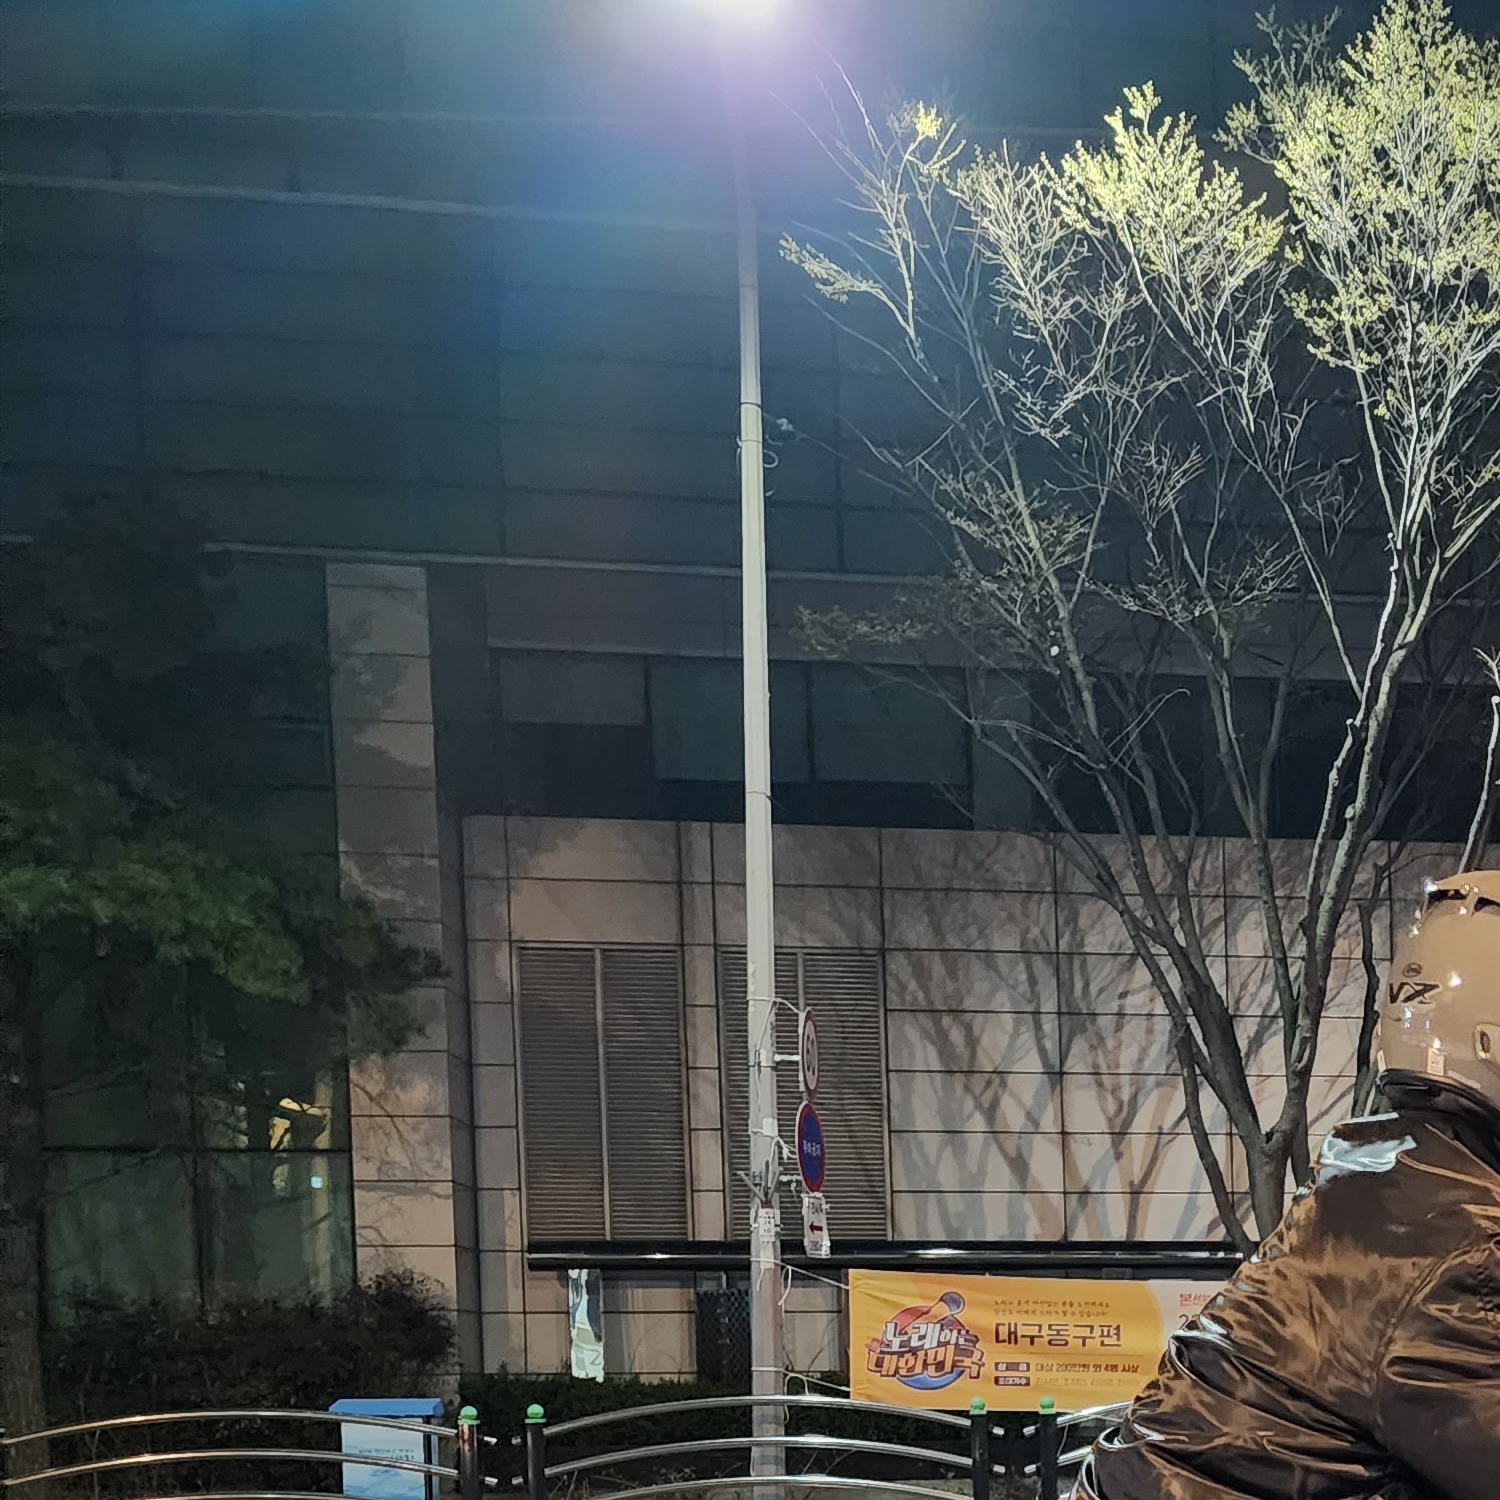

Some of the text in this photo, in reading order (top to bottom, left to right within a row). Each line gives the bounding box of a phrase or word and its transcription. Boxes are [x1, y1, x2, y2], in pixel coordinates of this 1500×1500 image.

[880, 1321, 979, 1352] 노래하는
[994, 1321, 1122, 1348] 대구동구편
[866, 1345, 986, 1378] 대한민국
